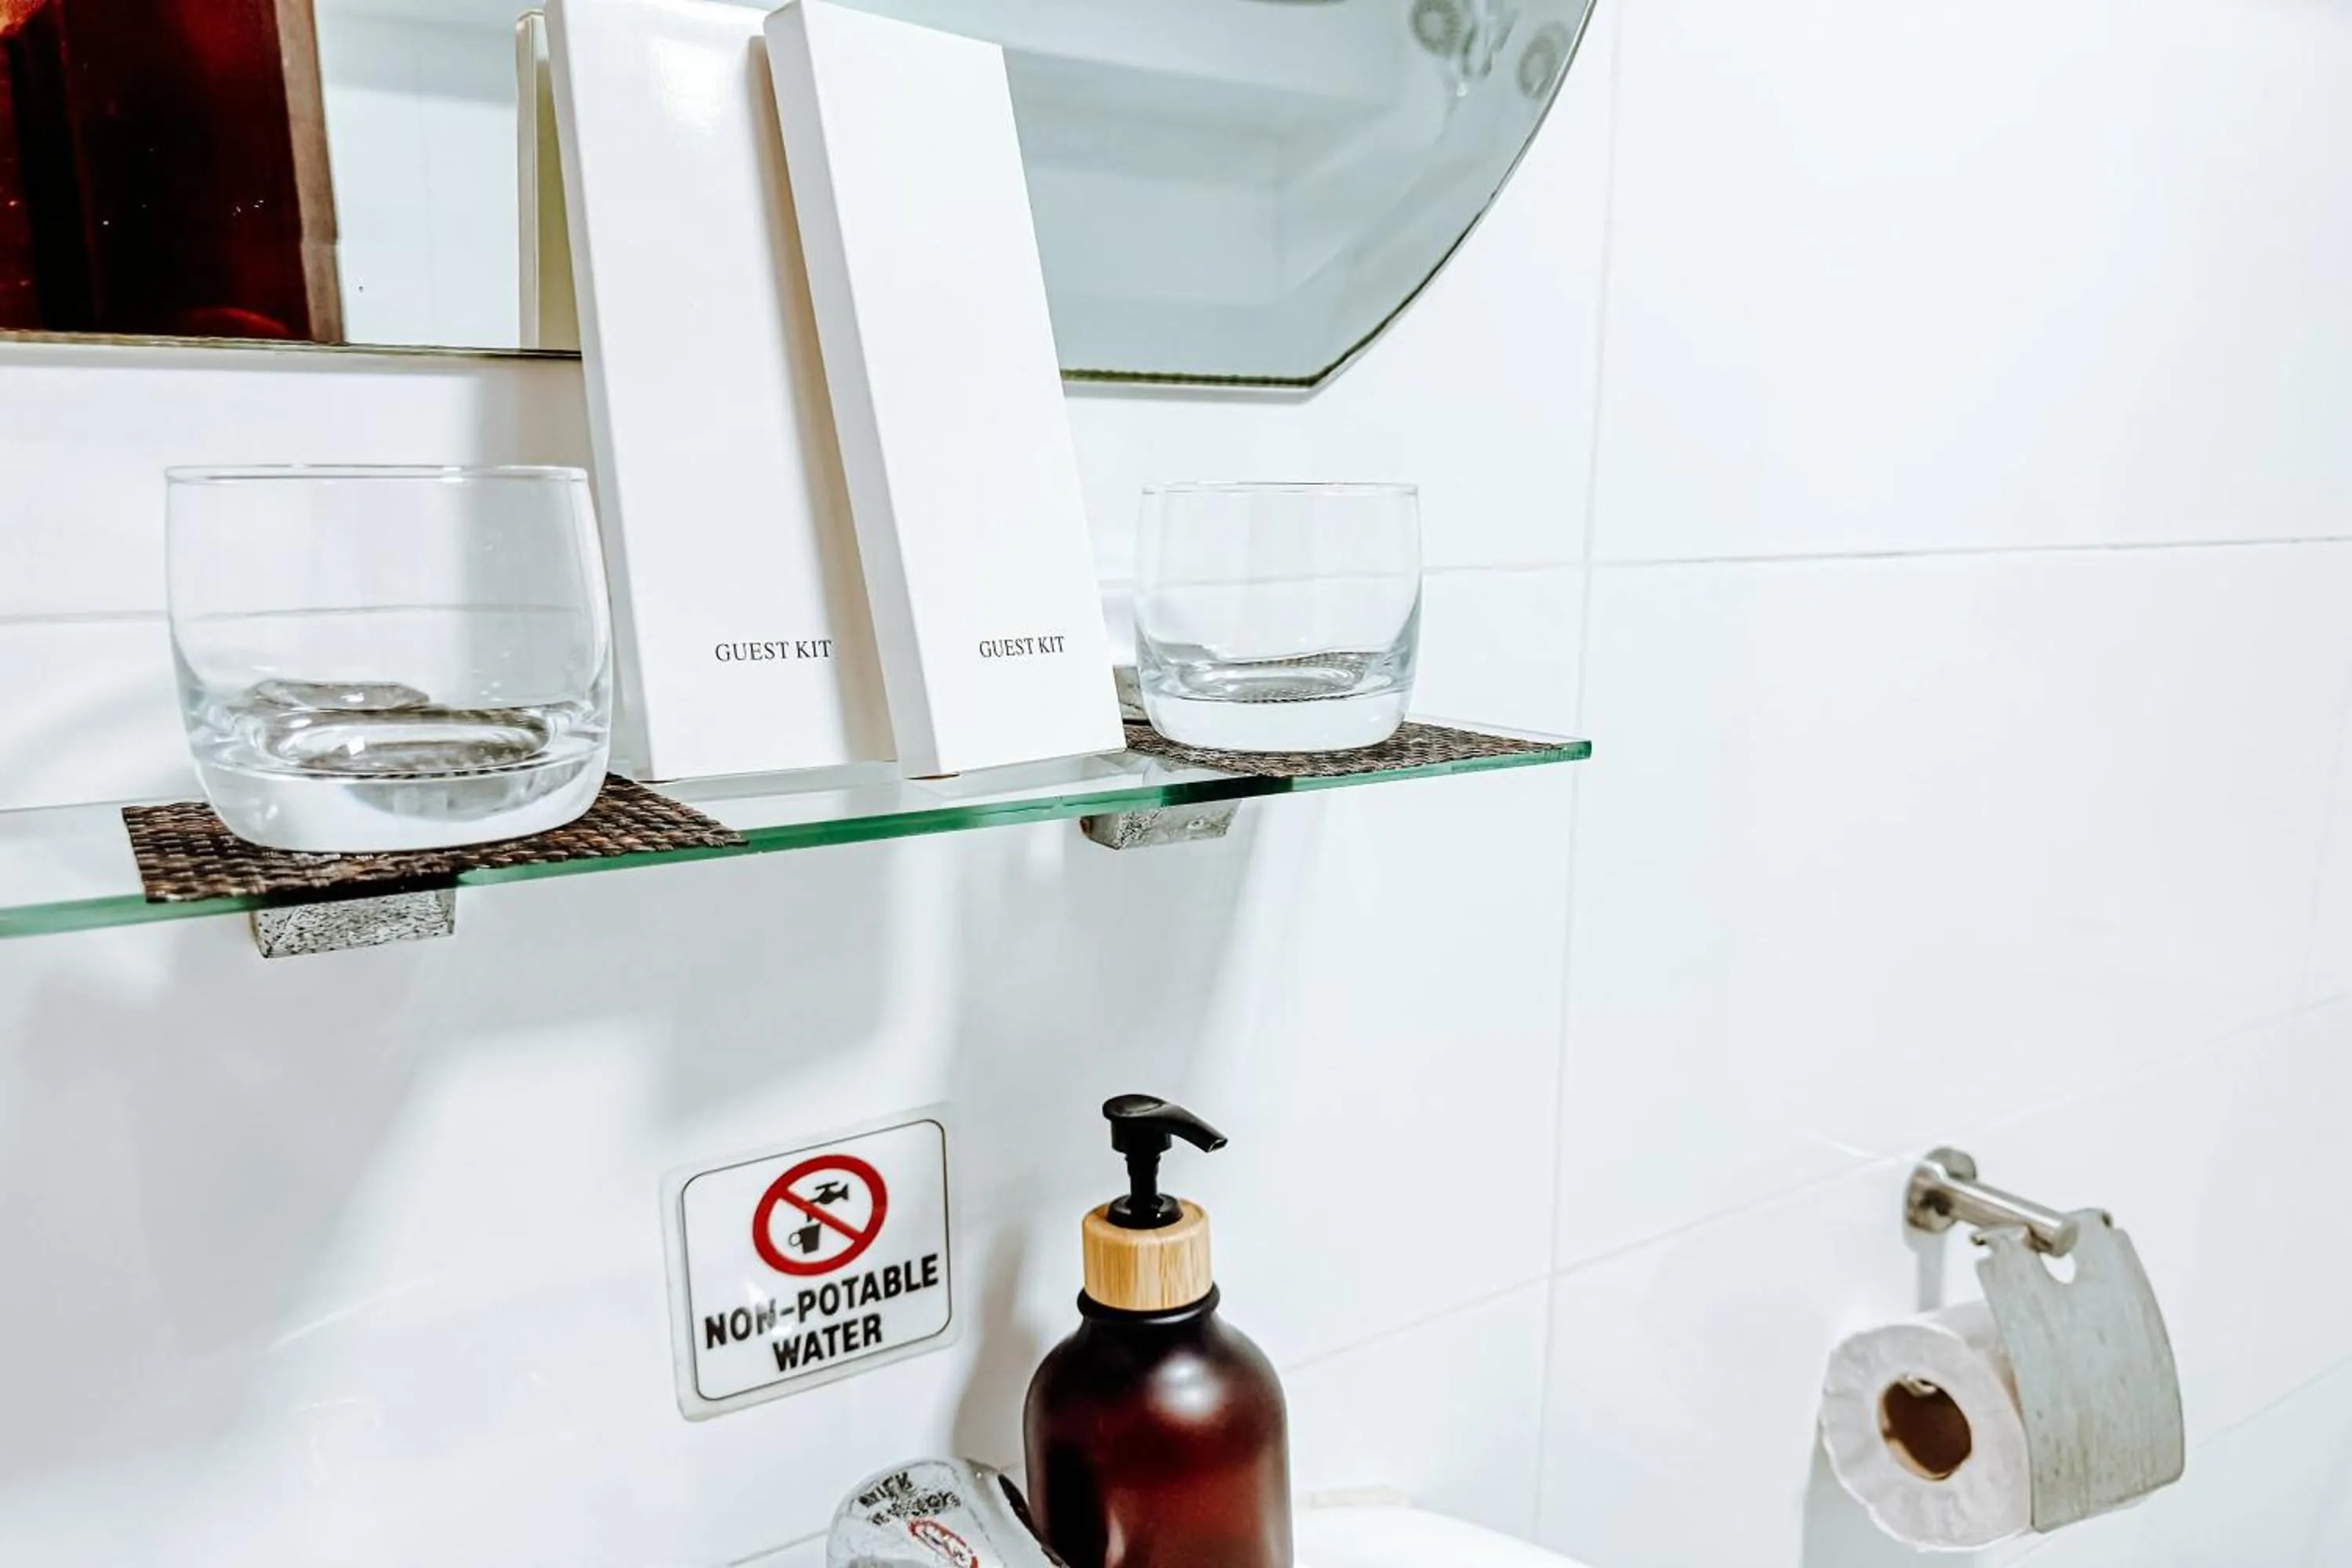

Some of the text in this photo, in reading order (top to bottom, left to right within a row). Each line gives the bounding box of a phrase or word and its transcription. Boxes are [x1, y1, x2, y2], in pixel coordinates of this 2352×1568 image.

[714, 639, 832, 661] GUEST KIT
[979, 636, 1065, 658] GUEST KIT
[705, 1254, 938, 1349] NON-POTABLE
[772, 1313, 882, 1371] WATER
